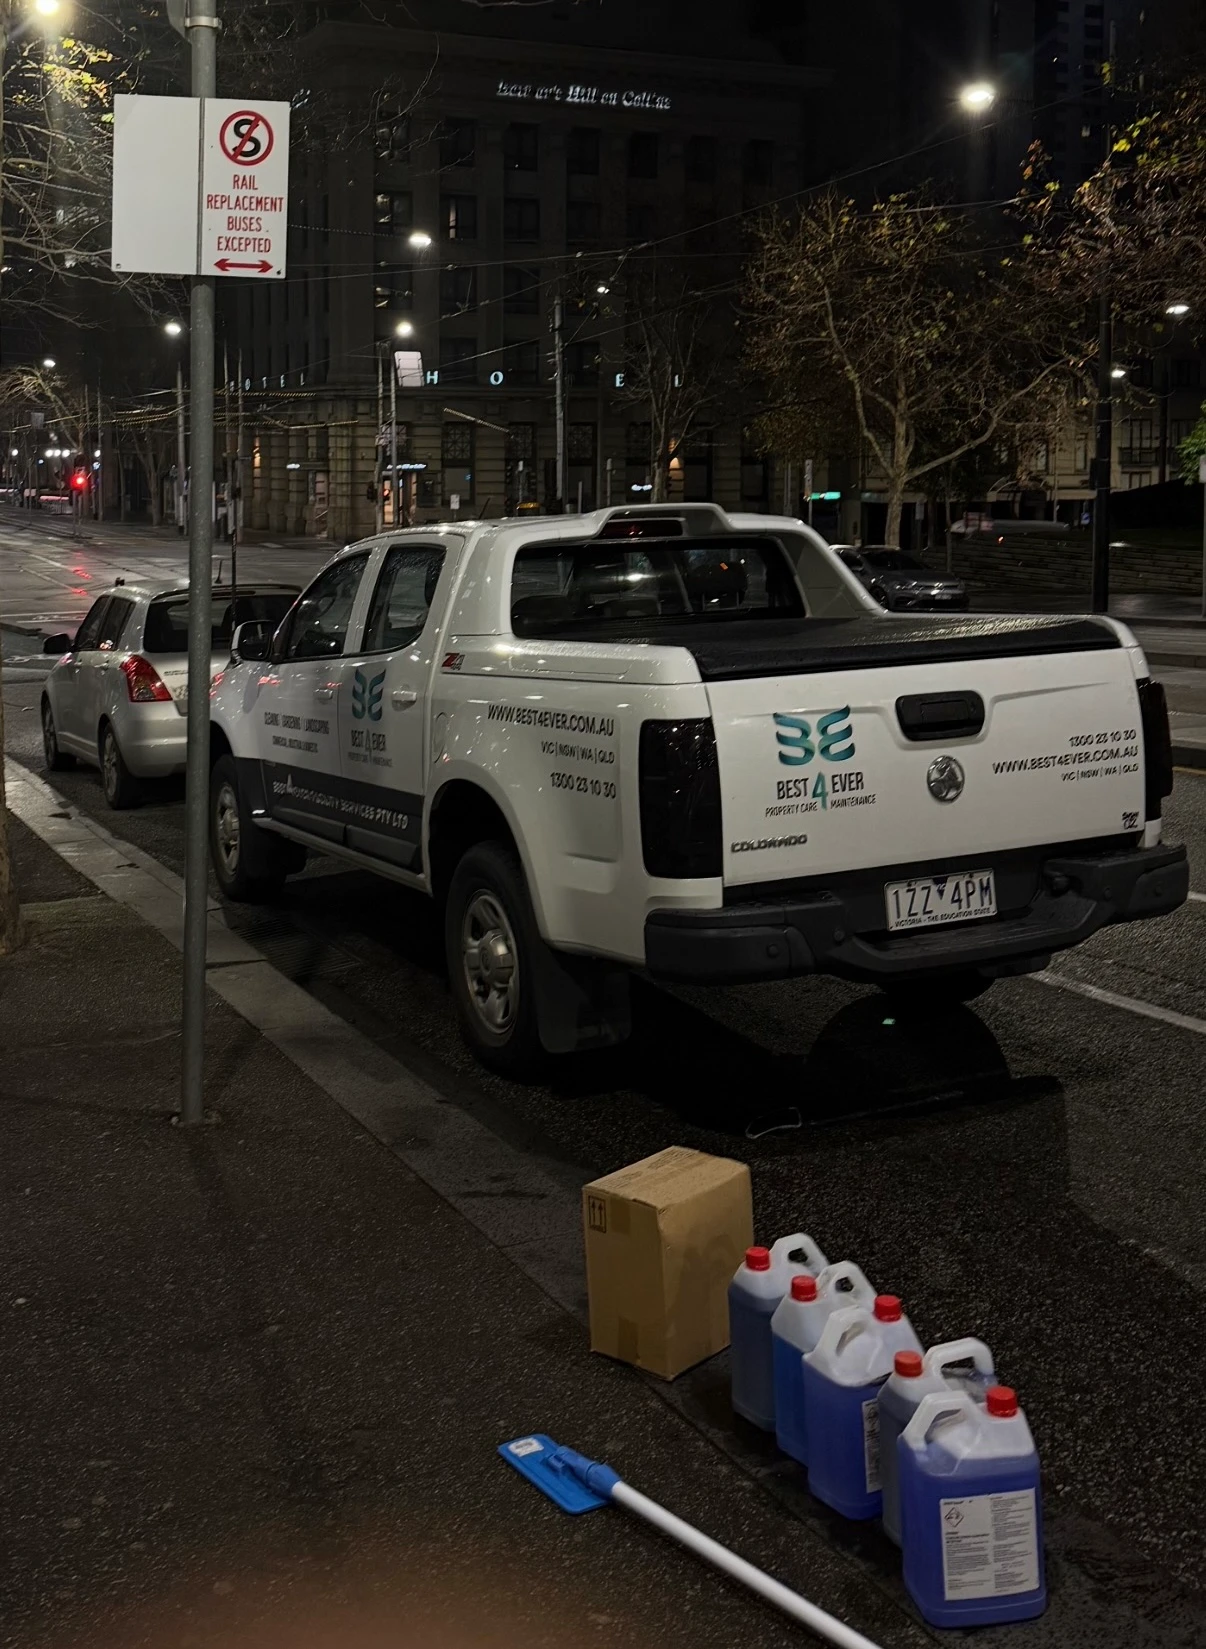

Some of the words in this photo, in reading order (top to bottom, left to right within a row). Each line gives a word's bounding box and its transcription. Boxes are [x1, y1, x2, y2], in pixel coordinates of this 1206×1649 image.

[566, 85, 597, 104] Hill
[233, 174, 258, 190] RAIL
[206, 194, 284, 213] REPLACEMENT
[227, 215, 262, 232] BUSES
[217, 236, 271, 253] EXCEPTED
[487, 704, 614, 736] WWW.BEST4EVER.COM.AU
[1069, 734, 1094, 748] 1300
[1095, 732, 1108, 745] 23
[1109, 730, 1122, 743] 10
[1123, 728, 1137, 741] 30
[992, 745, 1139, 774] WWW.BEST4EVER.COM.AU
[550, 771, 575, 791] 1300
[576, 776, 588, 793] 23
[589, 779, 601, 796] 10
[603, 781, 617, 799] 30
[776, 777, 809, 800] BEST
[812, 771, 829, 811] 4
[831, 771, 864, 794] EVER
[765, 803, 799, 818] PROPERTY
[800, 801, 818, 814] CARE
[830, 794, 877, 810] MAINTENANCE
[392, 812, 409, 830] LTD
[731, 834, 808, 854] COLORADO
[950, 876, 993, 910] 4PM
